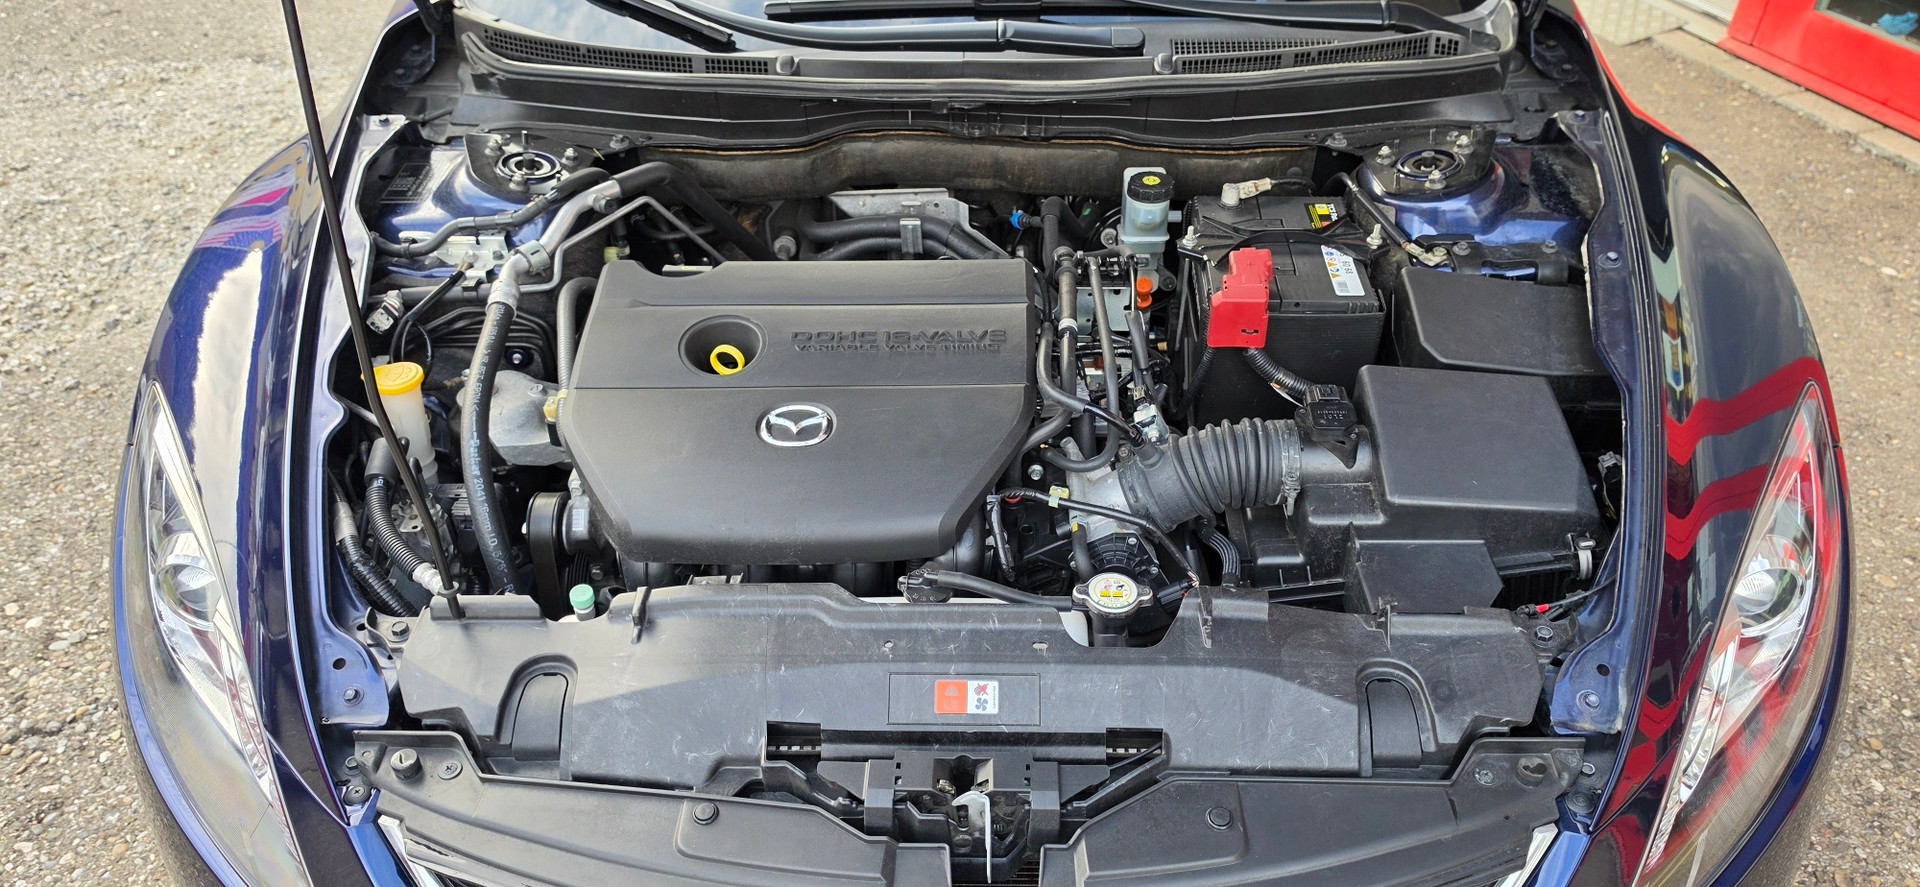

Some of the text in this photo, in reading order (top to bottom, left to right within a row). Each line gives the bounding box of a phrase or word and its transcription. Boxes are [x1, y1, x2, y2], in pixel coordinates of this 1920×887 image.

[791, 331, 878, 344] DOHC
[795, 343, 1000, 352] VARIABLE VALVE TIMING
[474, 477, 487, 501] 2041
[481, 502, 492, 531] 16mm
